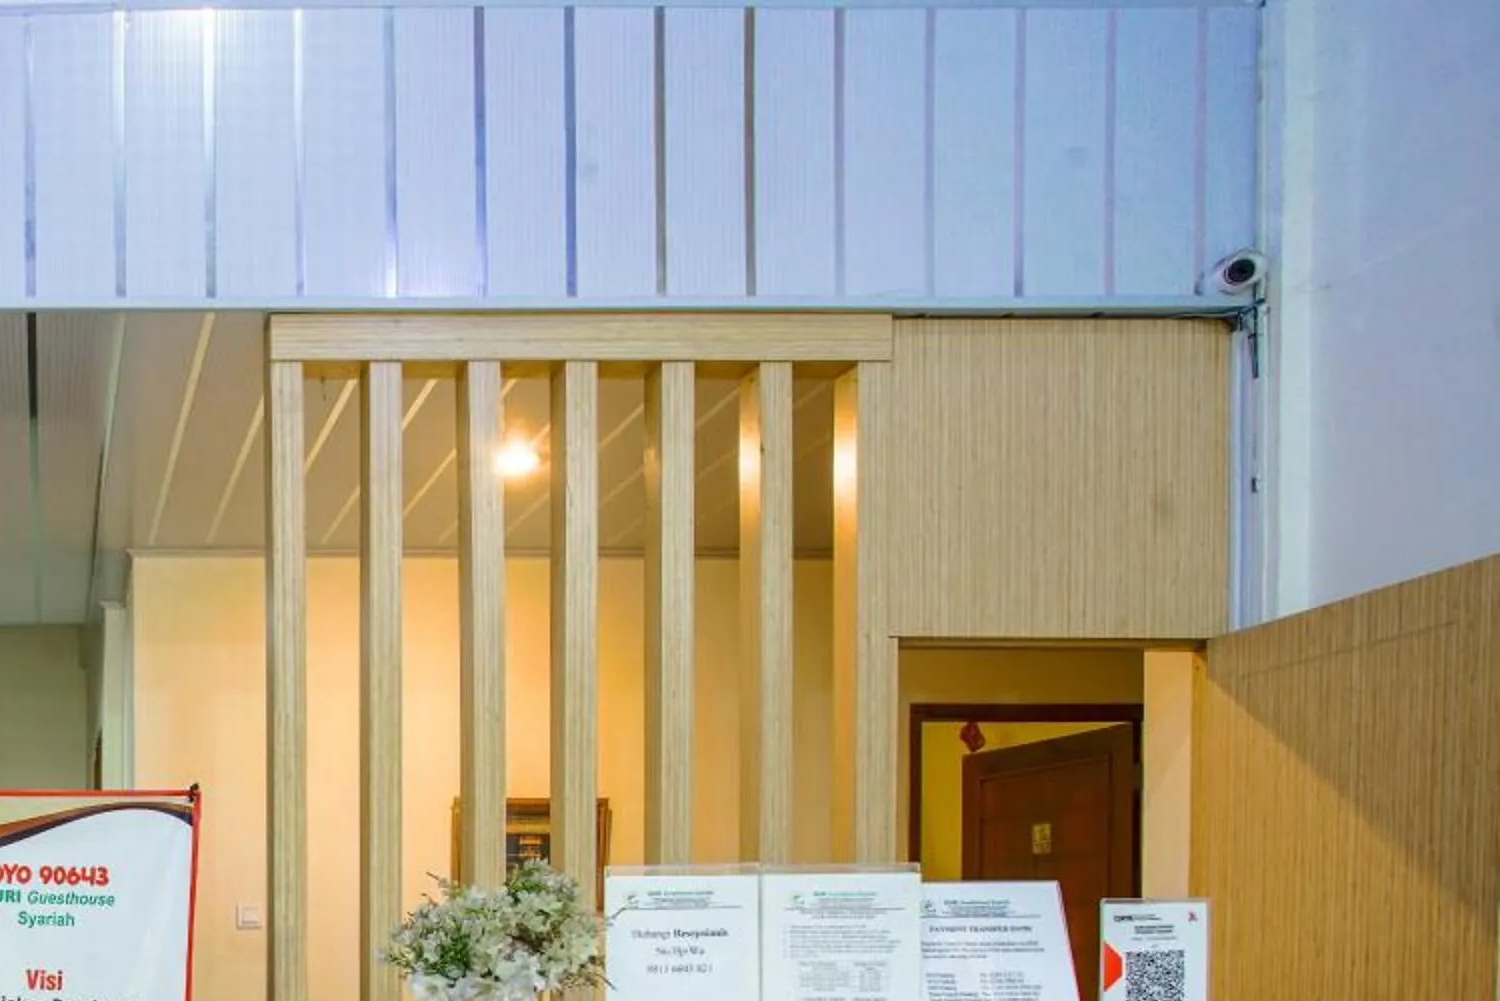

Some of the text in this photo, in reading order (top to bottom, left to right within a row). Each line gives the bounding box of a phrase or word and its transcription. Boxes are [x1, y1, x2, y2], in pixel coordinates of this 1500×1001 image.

[39, 865, 109, 886] 90643
[27, 889, 115, 907] Guesthouse
[18, 911, 75, 928] Syariah
[25, 969, 63, 991] Visi
